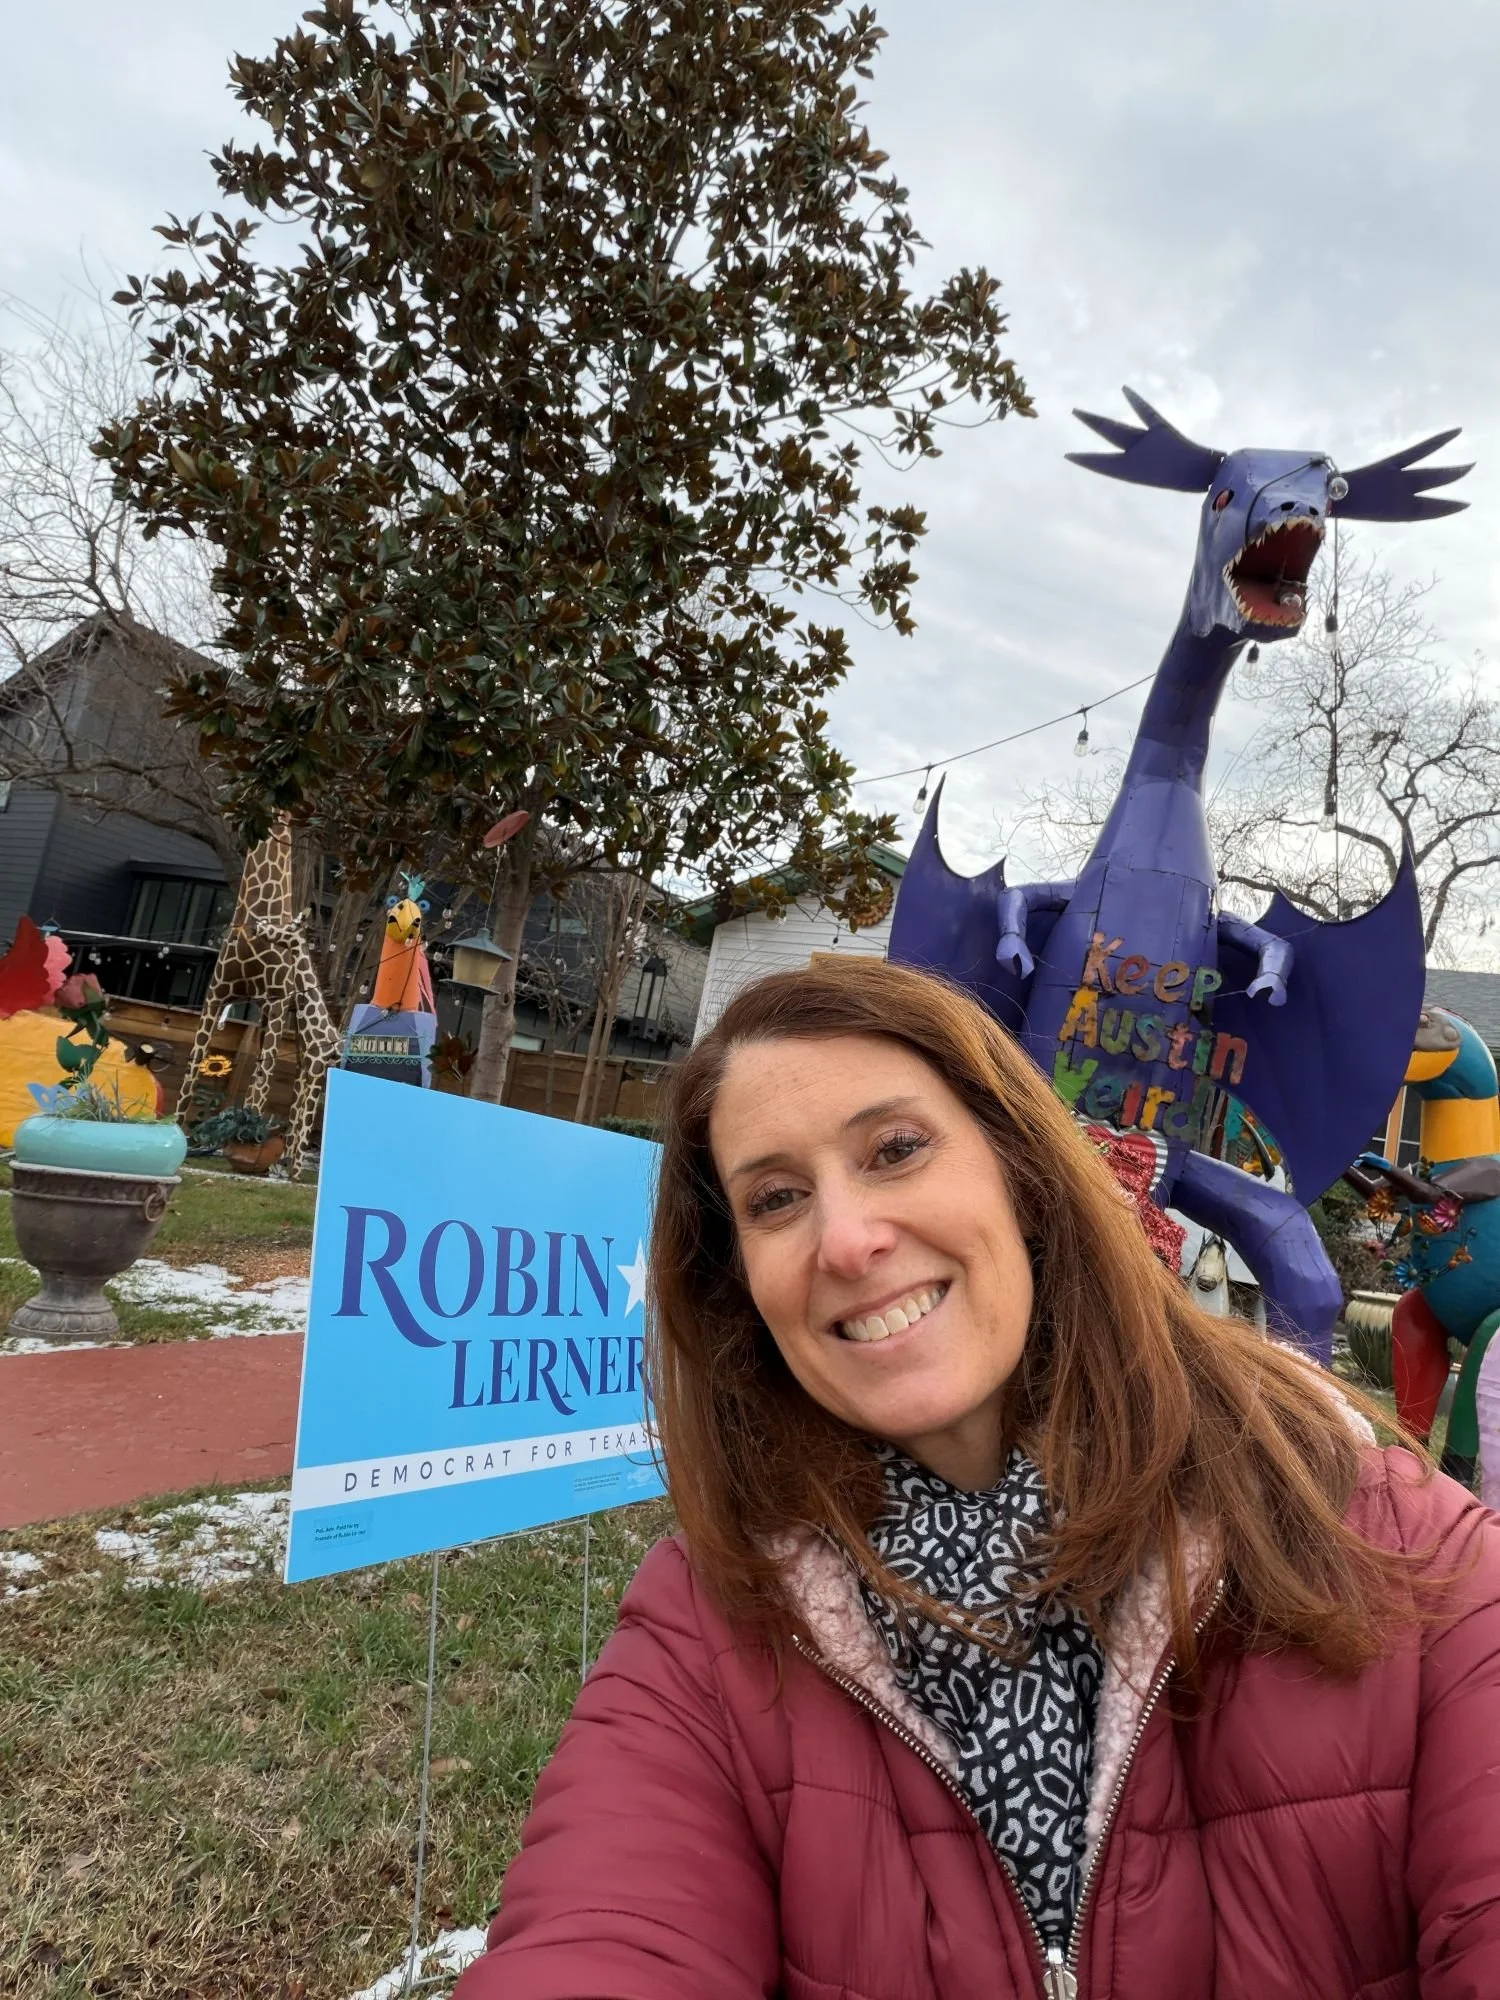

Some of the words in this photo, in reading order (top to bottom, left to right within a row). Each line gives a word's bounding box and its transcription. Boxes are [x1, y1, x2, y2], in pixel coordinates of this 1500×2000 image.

[1082, 931, 1223, 1011] Keep
[1058, 985, 1248, 1085] Austin
[331, 1205, 615, 1348] ROBIN
[344, 1450, 511, 1492] DEMOCRAT
[531, 1441, 572, 1462] FOR
[589, 1431, 648, 1452] TEXAS
